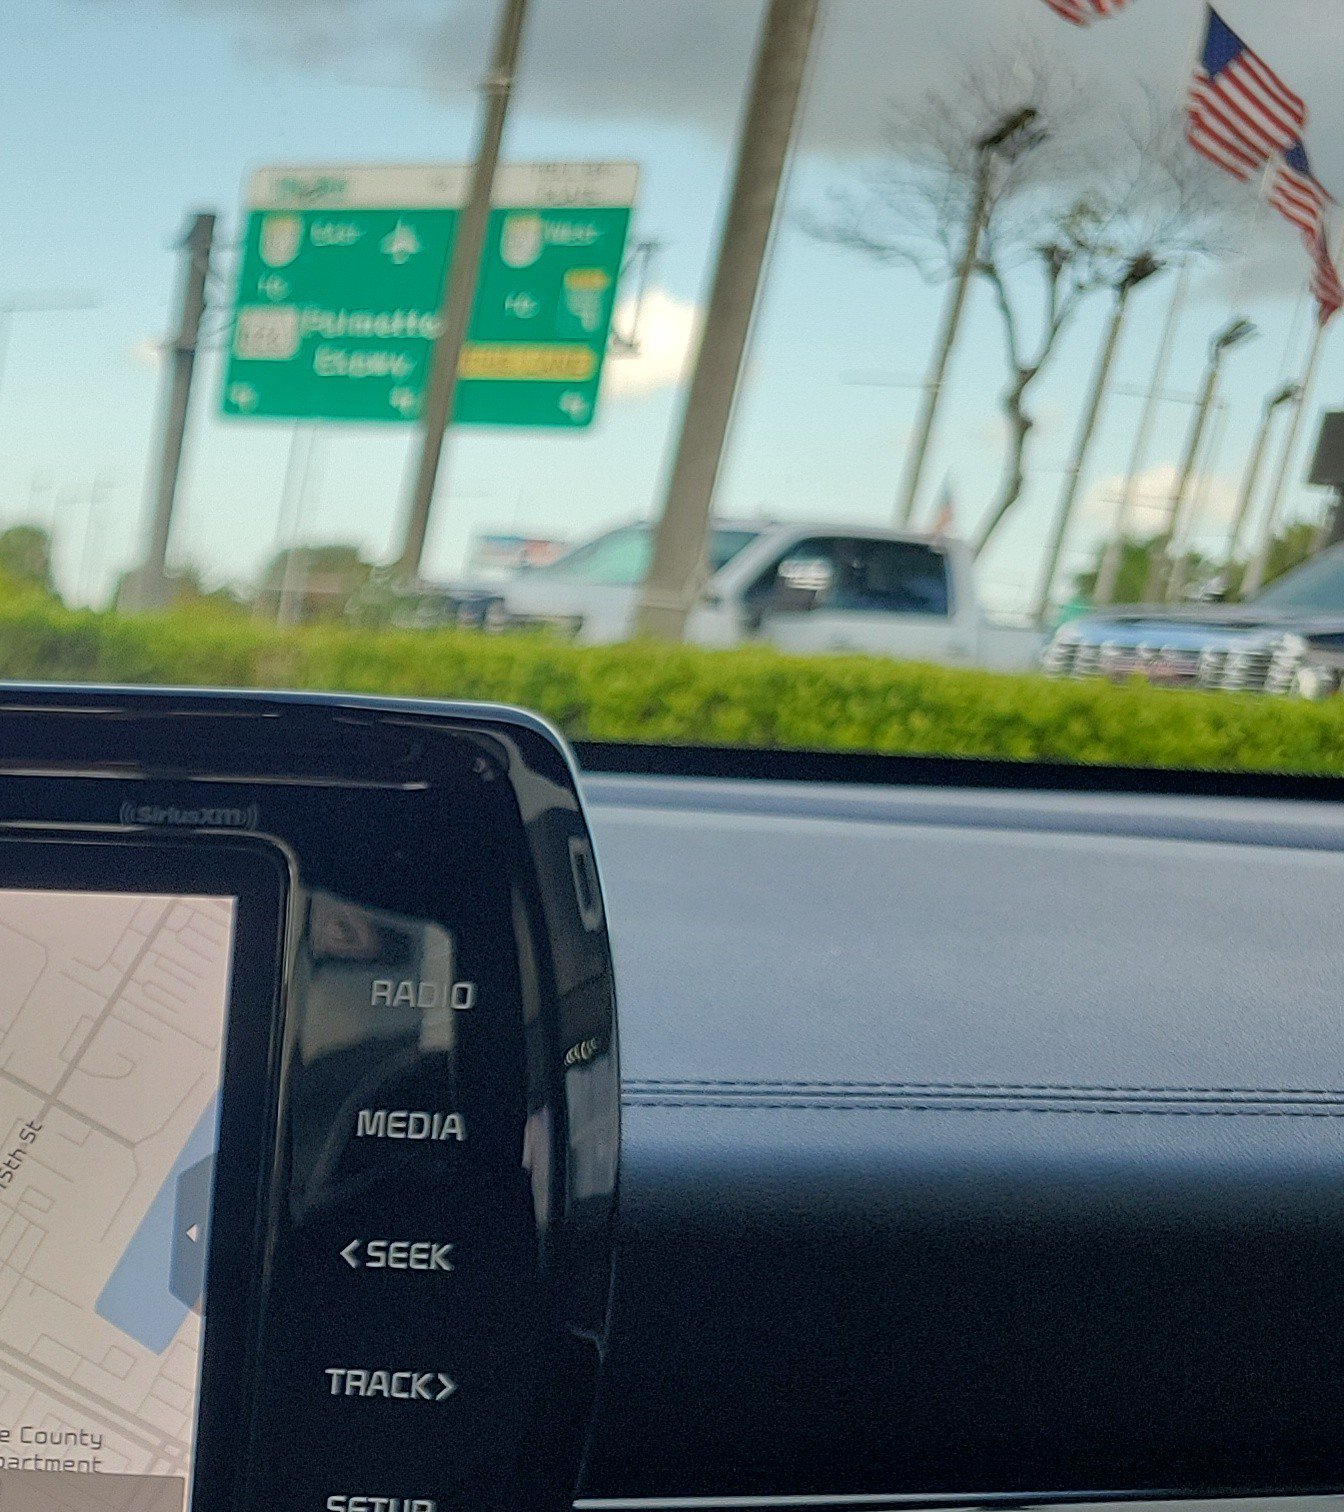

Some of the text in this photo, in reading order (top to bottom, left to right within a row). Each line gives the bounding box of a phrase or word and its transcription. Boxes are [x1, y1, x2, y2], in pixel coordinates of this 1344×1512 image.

[371, 979, 474, 1010] RADIO
[19, 1120, 43, 1144] St
[356, 1109, 465, 1141] MEDIA
[365, 1240, 455, 1271] SEEK
[324, 1367, 435, 1400] TRACK
[20, 1425, 104, 1450] County
